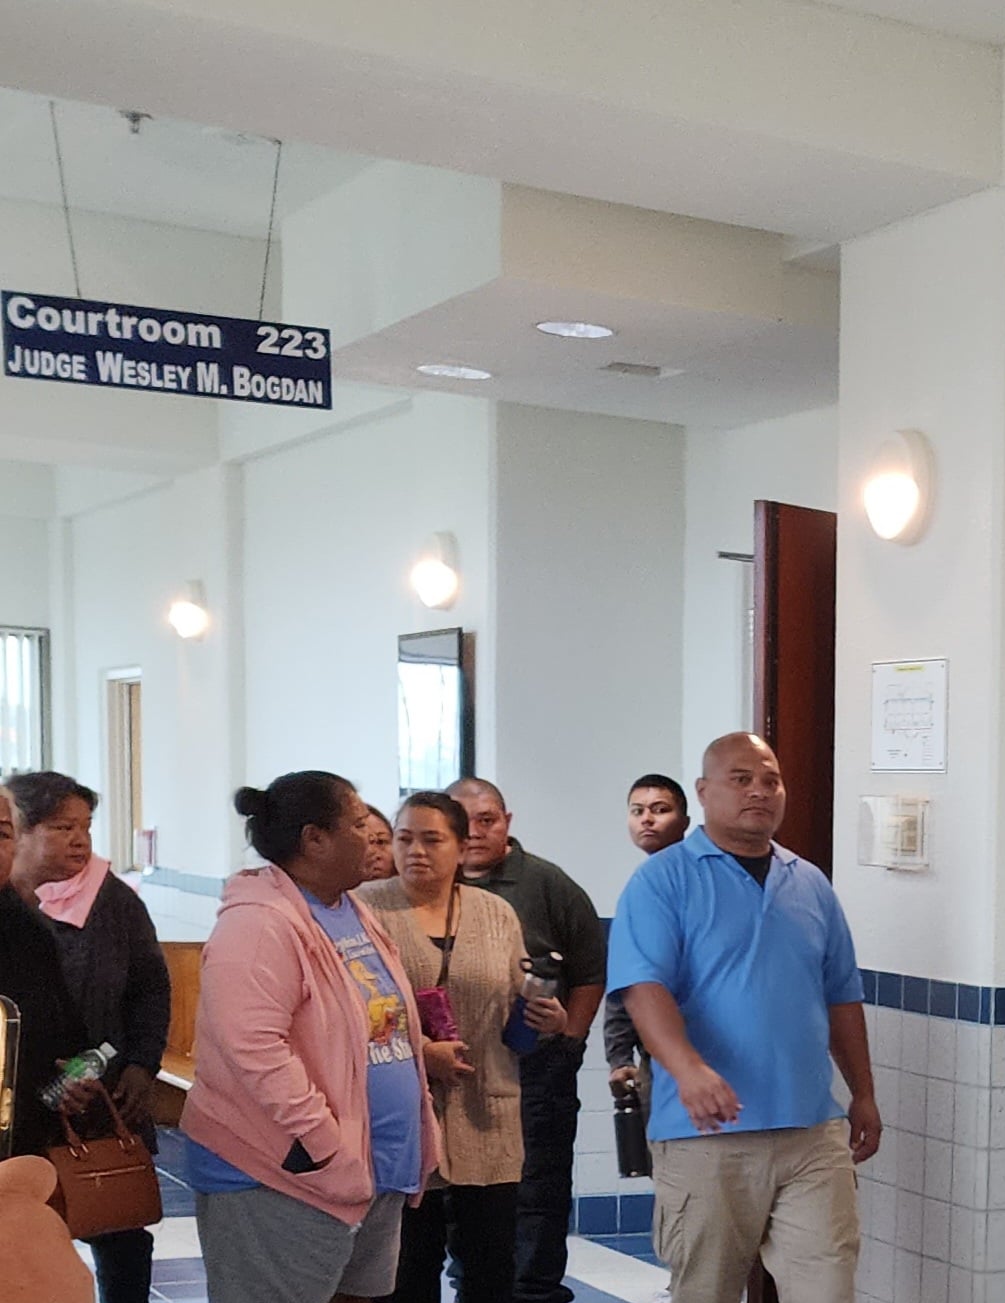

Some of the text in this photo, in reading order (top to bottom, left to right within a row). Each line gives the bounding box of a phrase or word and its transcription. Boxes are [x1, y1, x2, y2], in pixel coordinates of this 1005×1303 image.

[7, 296, 327, 360] Courtroom 223
[8, 344, 324, 405] JUDGE WESLEY M. BOGDAN
